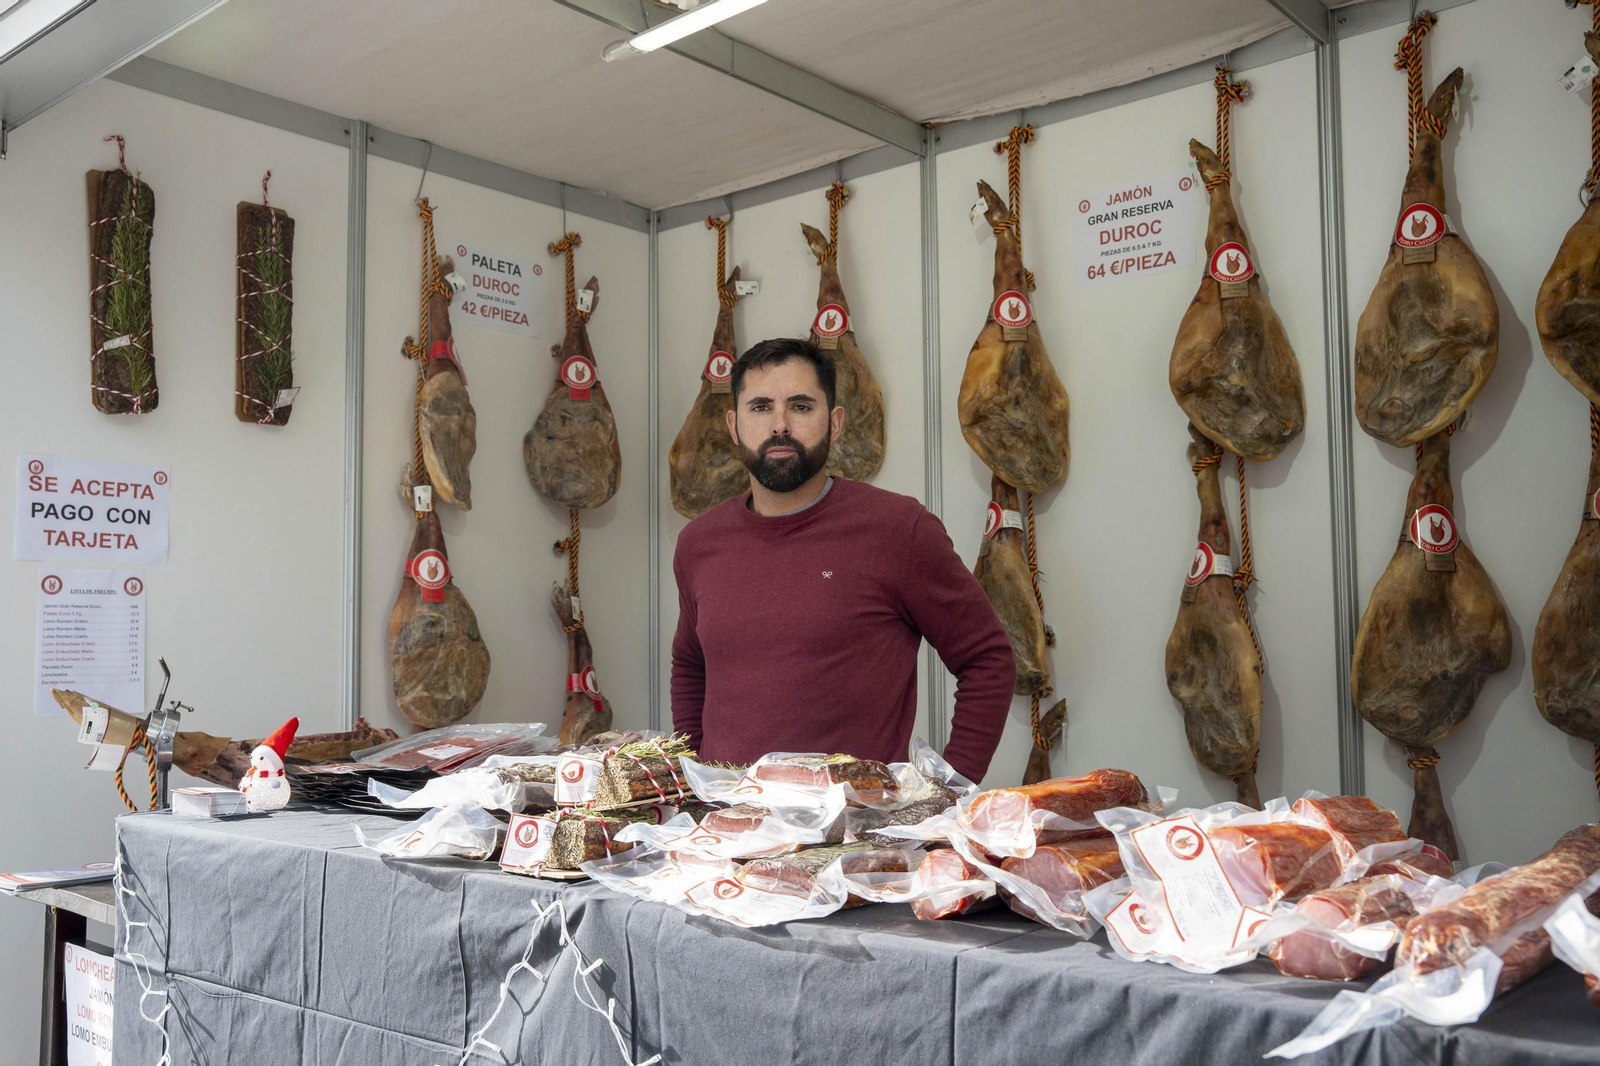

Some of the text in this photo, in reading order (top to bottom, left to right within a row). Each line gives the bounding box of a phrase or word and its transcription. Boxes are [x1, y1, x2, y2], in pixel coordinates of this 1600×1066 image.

[1106, 186, 1152, 206] JAMÓN
[1088, 200, 1174, 226] GRAN RESERVA
[1100, 220, 1162, 245] DUROC
[1101, 248, 1121, 257] PIEZAS
[472, 254, 521, 277] PALETA
[1088, 251, 1176, 280] 64 €/PIEZA
[473, 274, 520, 296] DUROC
[462, 301, 529, 326] 42 €/PIEZA
[29, 475, 154, 500] SE ACEPTA
[31, 502, 150, 525] PAGO CON
[43, 530, 139, 550] TARJETA
[77, 1004, 95, 1022] LOMO
[72, 1023, 90, 1042] LOMO
